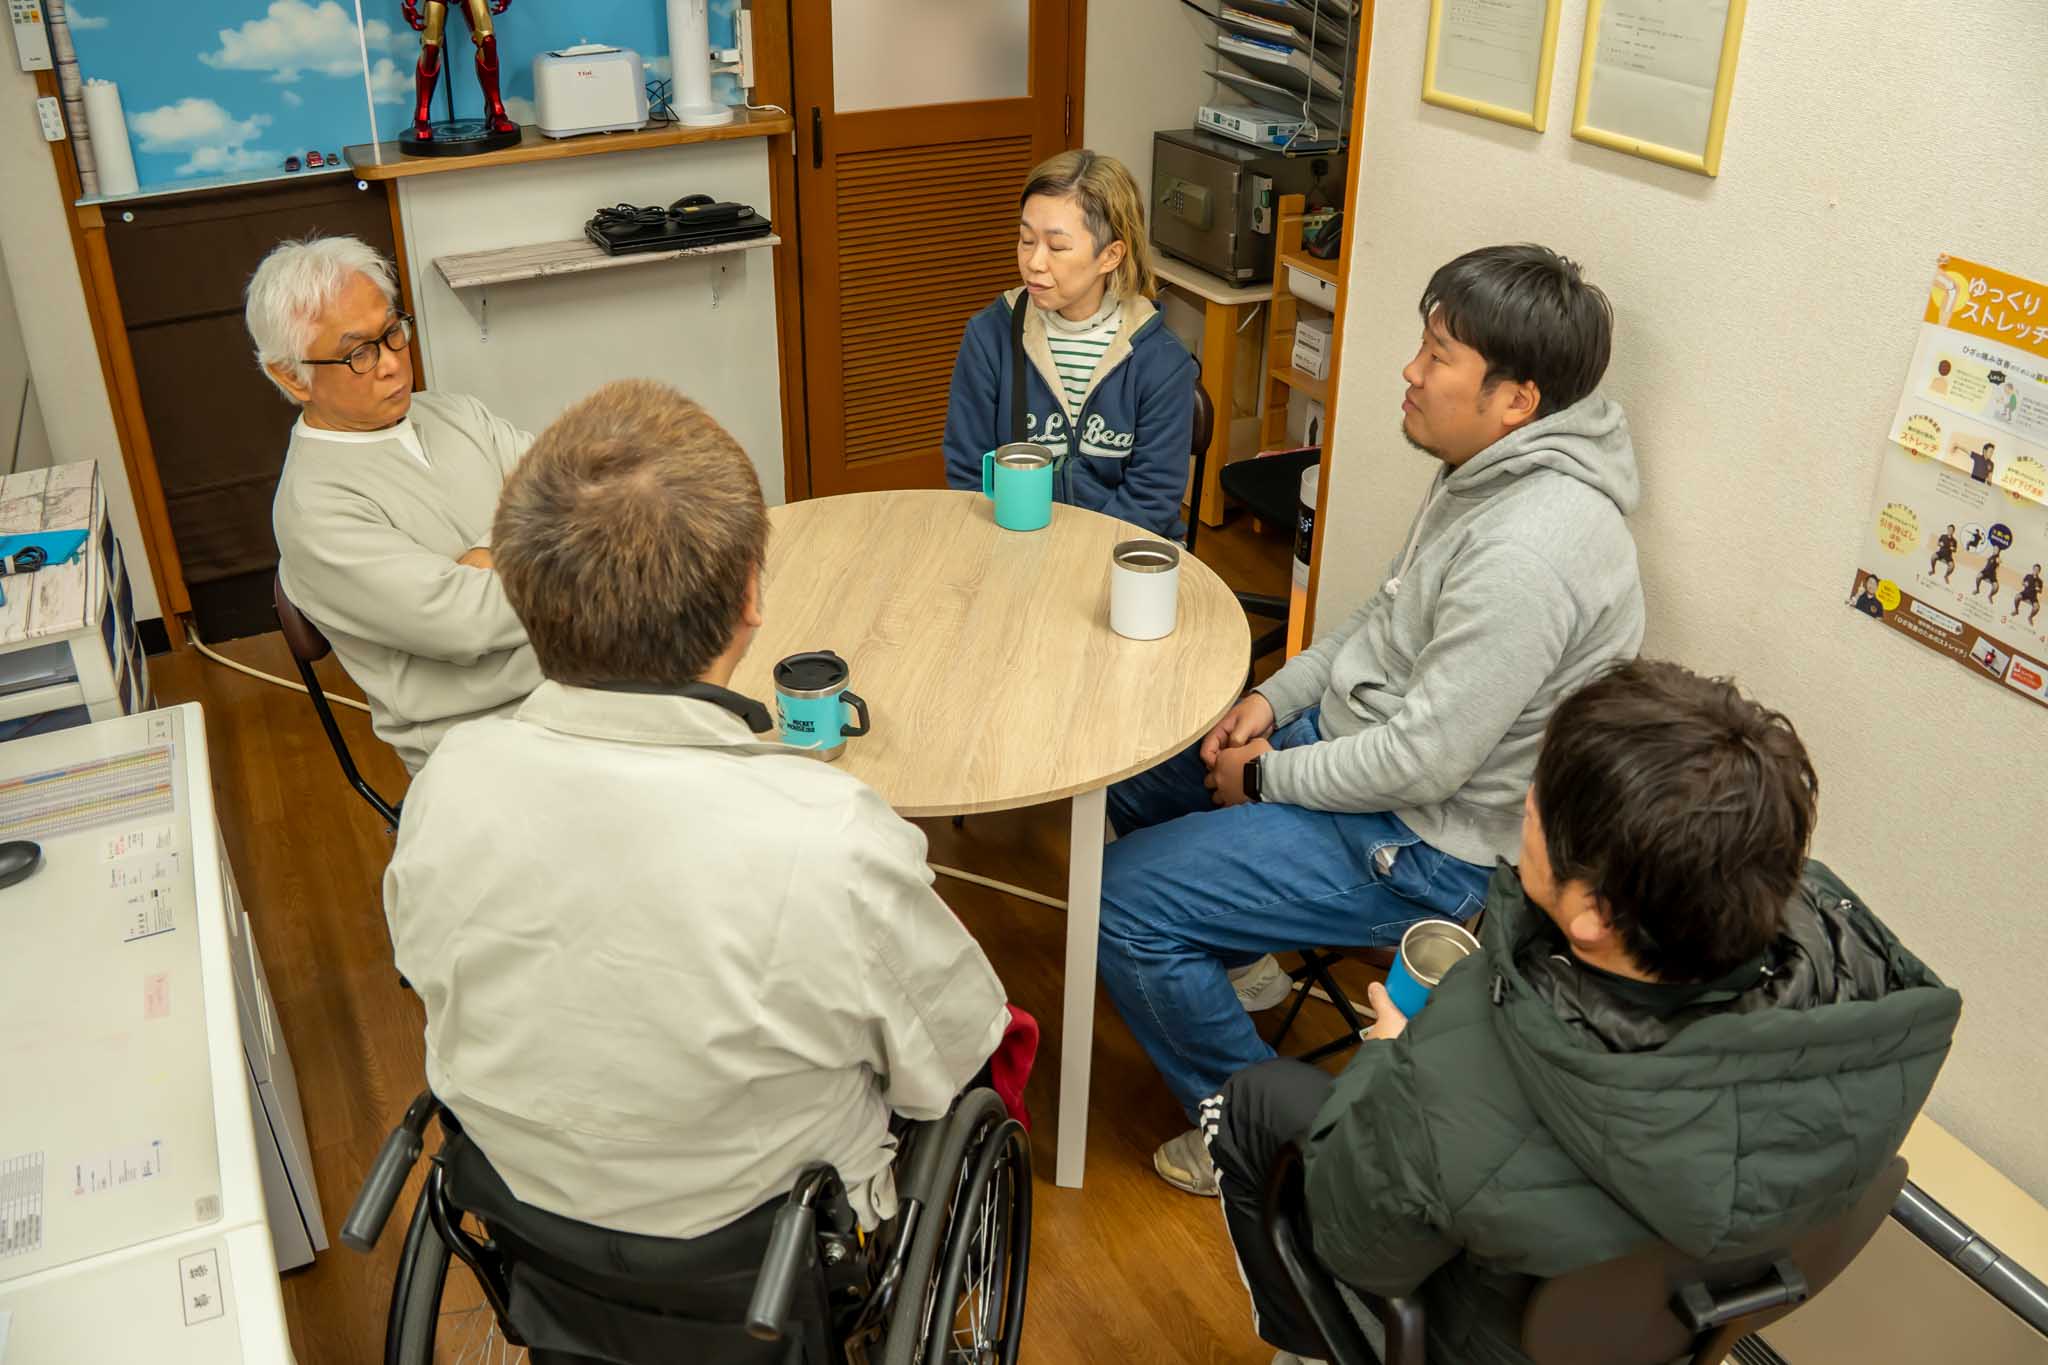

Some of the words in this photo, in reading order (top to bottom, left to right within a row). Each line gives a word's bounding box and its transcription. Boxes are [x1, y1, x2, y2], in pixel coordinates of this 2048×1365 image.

[1968, 277, 2041, 316] ゆっくり
[1960, 301, 2048, 345] ストレッチ
